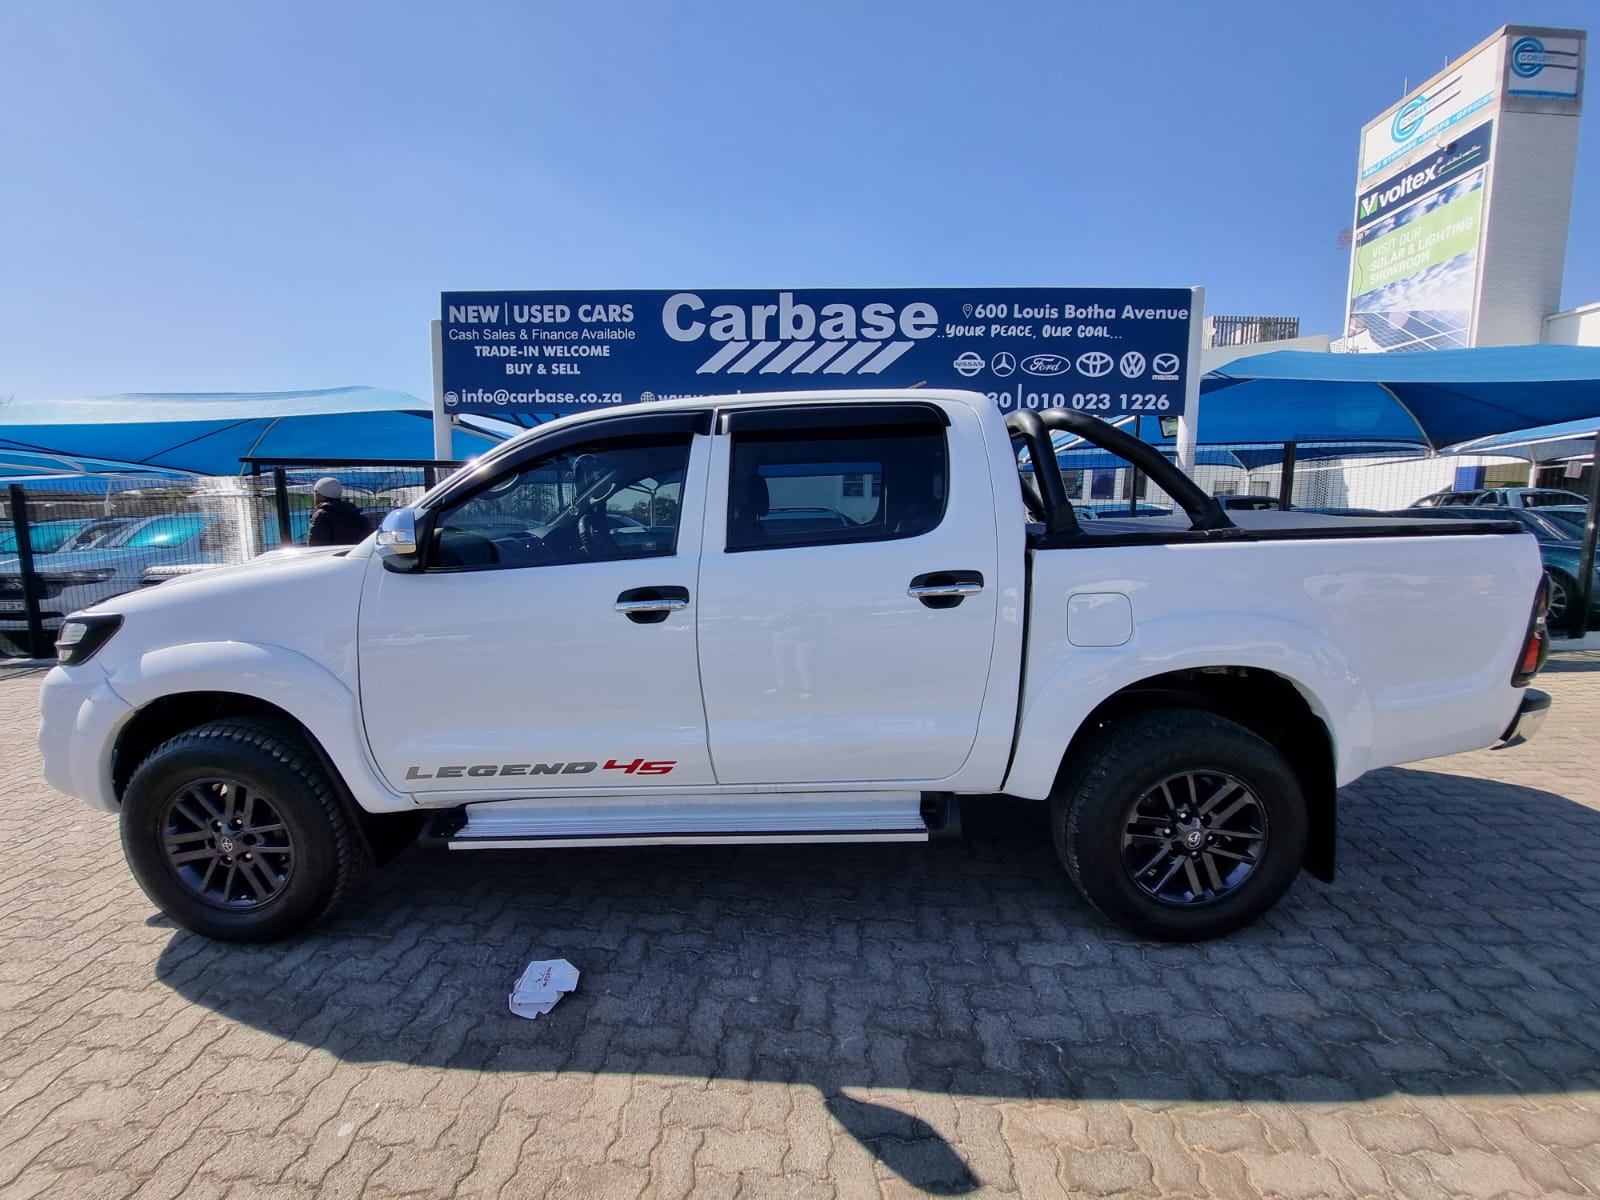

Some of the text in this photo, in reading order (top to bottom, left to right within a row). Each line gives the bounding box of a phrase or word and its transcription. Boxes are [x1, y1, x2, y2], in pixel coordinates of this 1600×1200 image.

[1378, 163, 1438, 208] voltex
[1370, 216, 1474, 272] SOLAR & LIGHTING
[1372, 226, 1423, 258] VISIT OUR
[1369, 249, 1430, 285] SHOWROOM
[449, 304, 635, 323] NEW USED CARS
[662, 292, 939, 342] Carbase
[974, 303, 1189, 320] 600 Louis Botha Avenue
[449, 327, 636, 341] Cash Sales & Finance Available
[1042, 324, 1073, 338] OUR
[474, 345, 610, 357] TRADE-IN WELCOME
[506, 363, 581, 375] BUY & SELL
[1030, 357, 1062, 371] Ford
[461, 388, 622, 405] info@carbase.co.za
[1026, 393, 1065, 408] 010
[1072, 393, 1111, 410] 023
[1119, 393, 1170, 410] 1226
[405, 758, 678, 780] LEGEND 45
